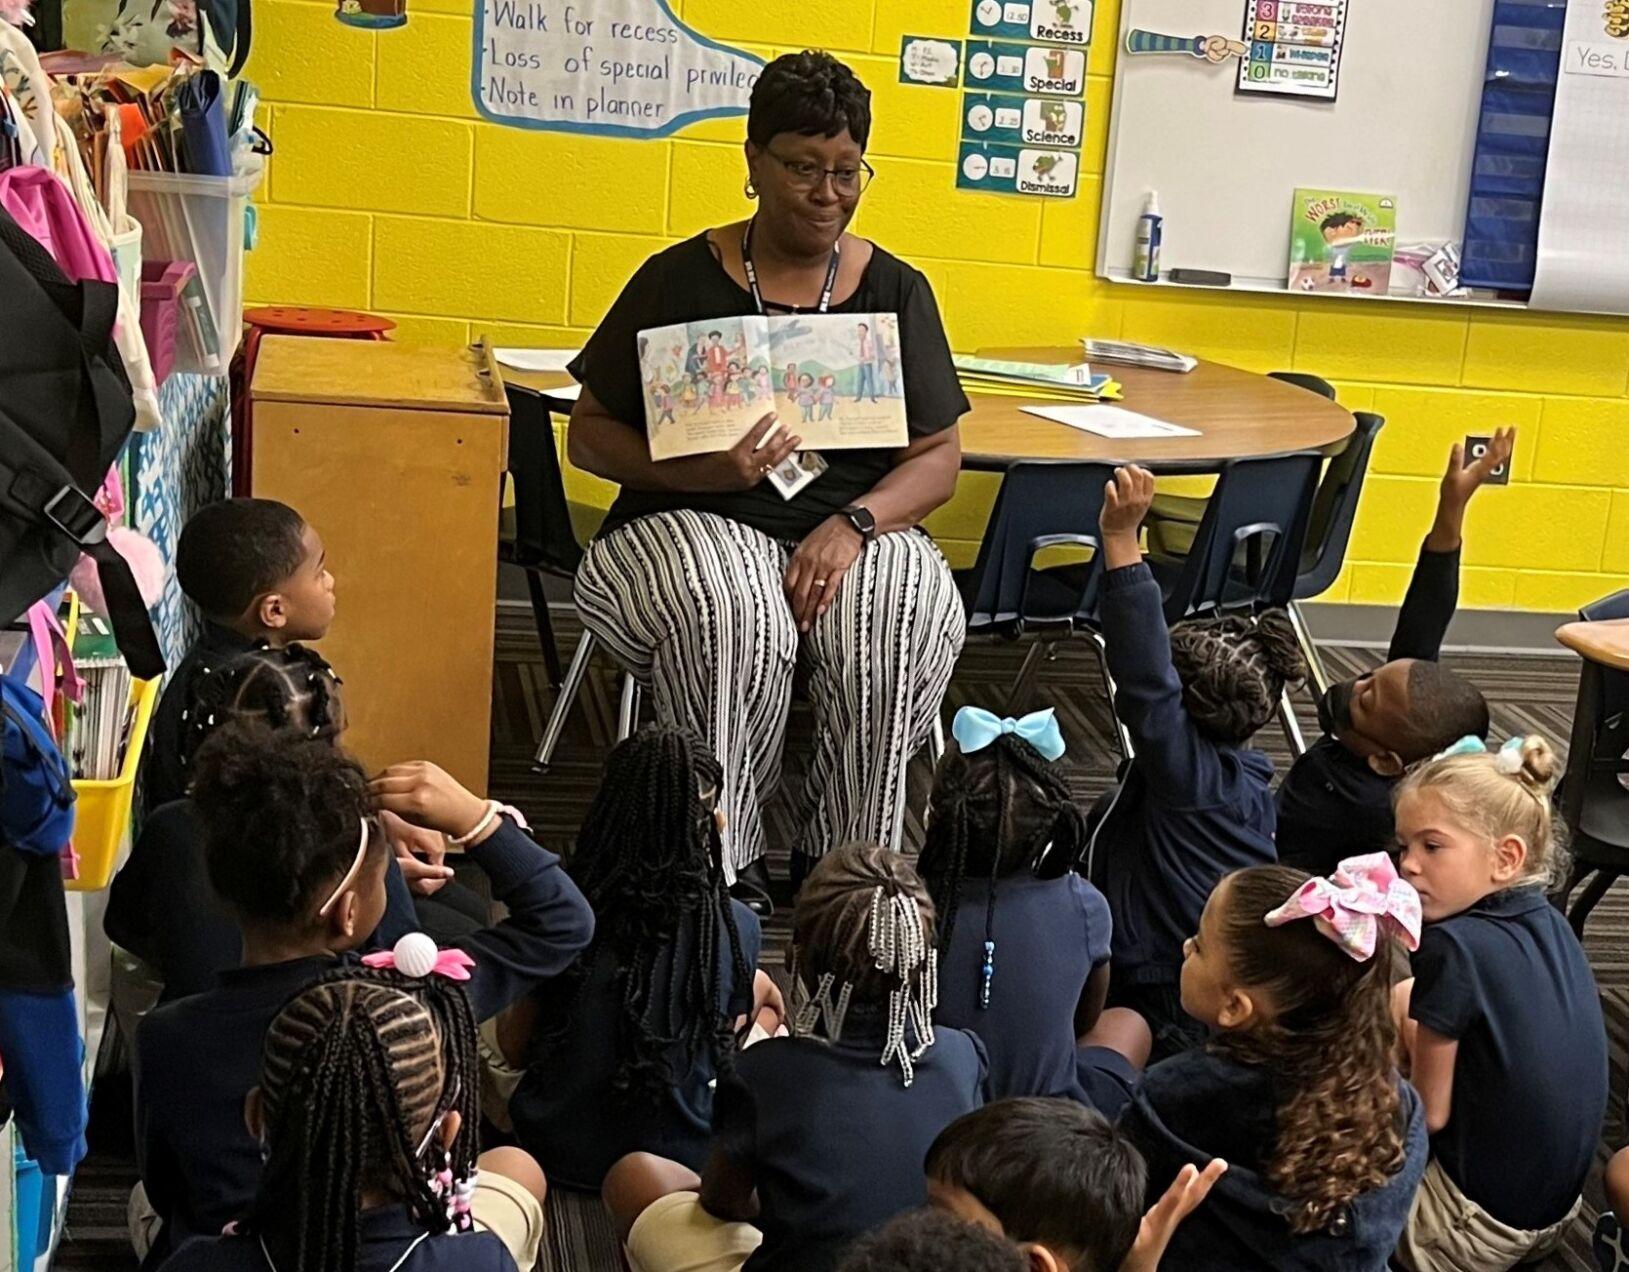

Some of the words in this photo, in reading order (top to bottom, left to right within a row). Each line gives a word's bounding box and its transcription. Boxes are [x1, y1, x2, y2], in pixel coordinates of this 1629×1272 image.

[1262, 4, 1273, 18] 3
[493, 0, 548, 32] Walk
[565, 6, 593, 36] for
[611, 22, 678, 44] recess
[1037, 25, 1083, 42] Recess
[1259, 25, 1270, 39] 2
[1256, 45, 1264, 59] 1
[491, 37, 540, 69] Loss
[564, 45, 593, 73] of
[600, 54, 669, 84] special
[1254, 65, 1266, 79] 0
[1030, 76, 1076, 92] Special
[489, 76, 538, 106] Note
[553, 94, 574, 109] in
[587, 86, 664, 119] planner
[1027, 129, 1075, 144] Science
[1021, 181, 1070, 194] Dismissal
[1305, 197, 1339, 222] WORST
